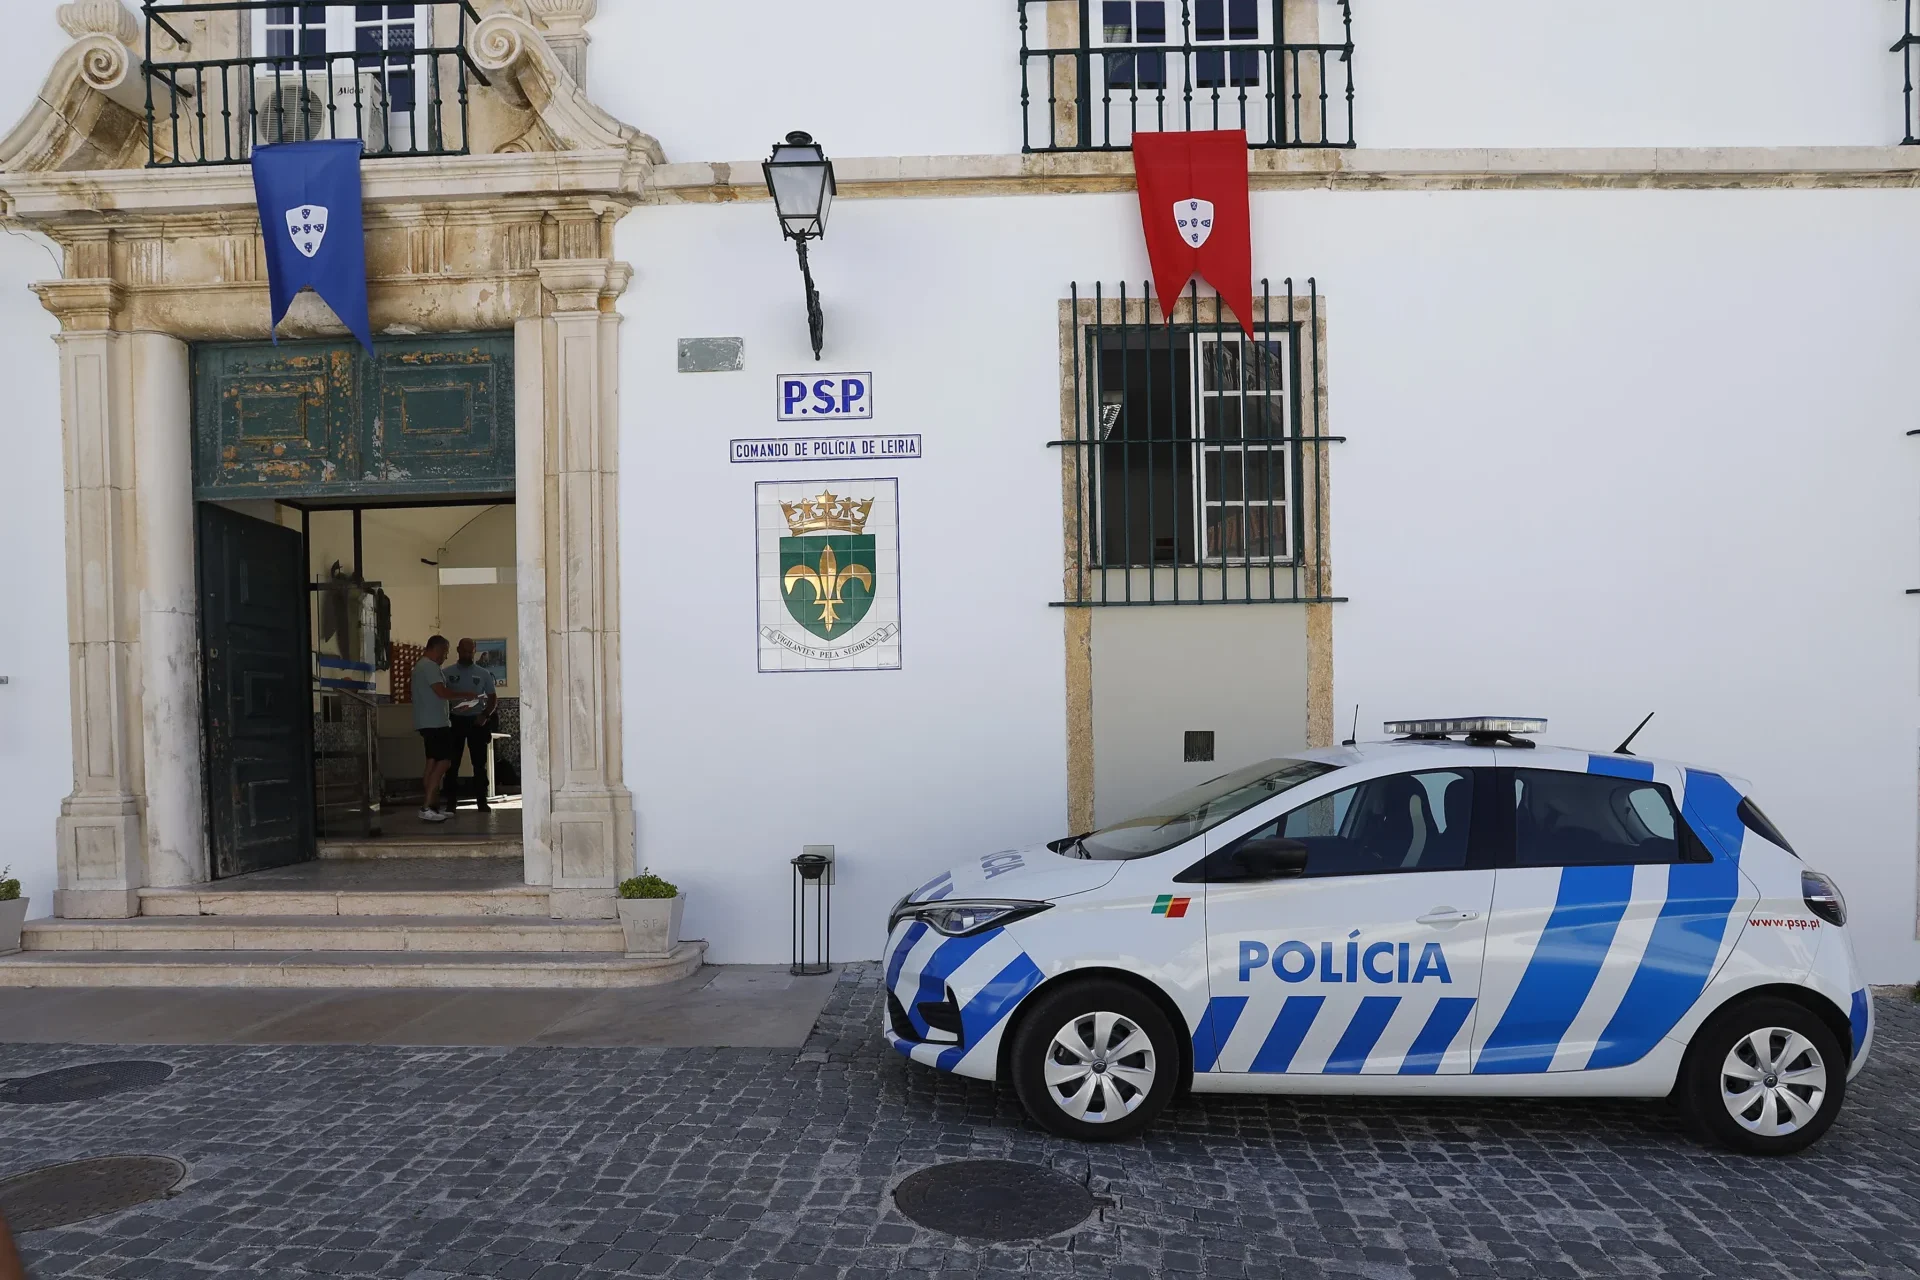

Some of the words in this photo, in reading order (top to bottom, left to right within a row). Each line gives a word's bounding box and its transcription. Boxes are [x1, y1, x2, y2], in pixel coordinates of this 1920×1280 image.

[337, 87, 364, 96] Mida
[784, 379, 865, 414] P.S.P.
[736, 443, 788, 457] COMANDO
[795, 442, 808, 456] DE
[814, 439, 856, 455] POLÍCIA
[862, 440, 875, 454] DE
[881, 439, 916, 454] LEIRIA
[776, 633, 815, 656] VIGILANTES
[844, 632, 883, 655] SEGURANÇA
[1748, 919, 1820, 930] www.psp.pt
[1239, 928, 1453, 984] POLÍCIA
